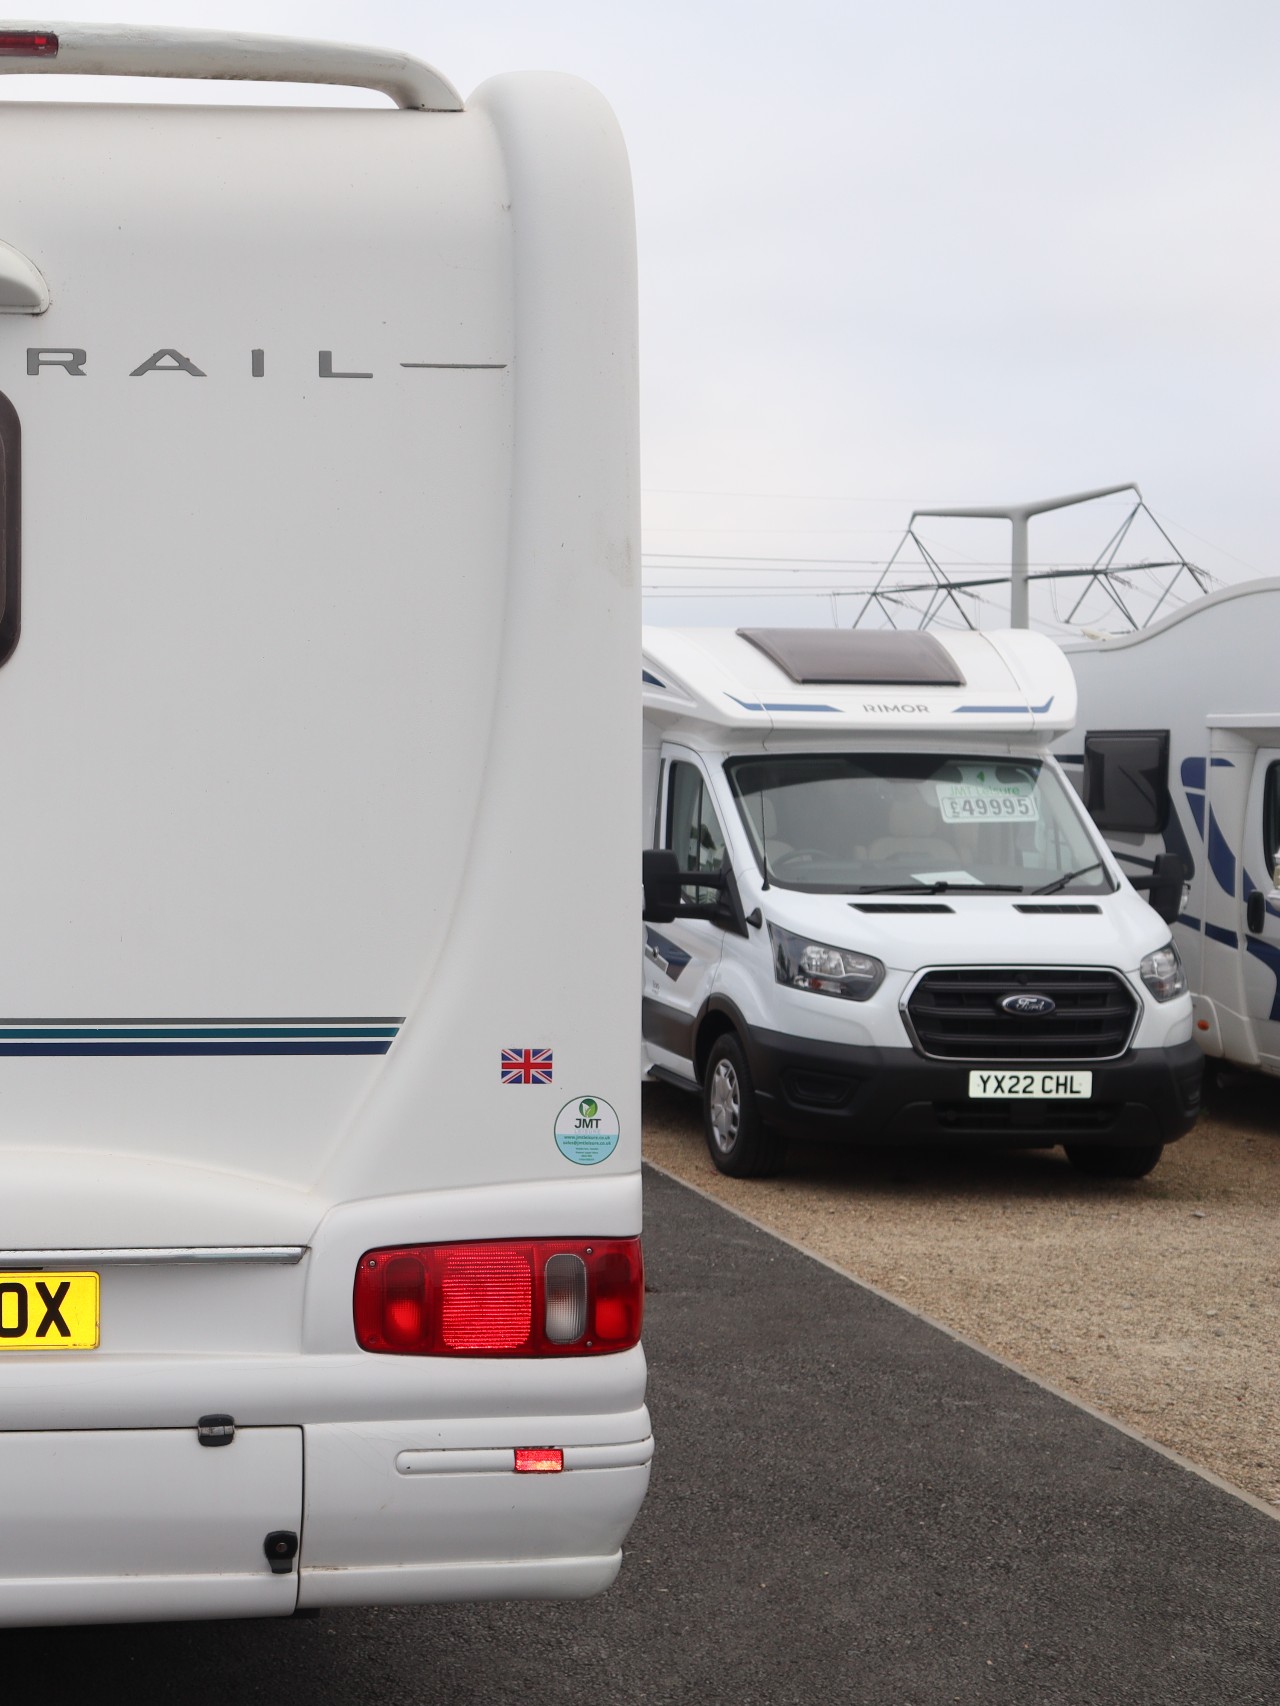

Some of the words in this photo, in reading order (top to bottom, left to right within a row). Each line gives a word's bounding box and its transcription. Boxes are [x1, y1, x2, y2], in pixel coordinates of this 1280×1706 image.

[862, 704, 930, 713] RIMOR
[950, 799, 1029, 817] £49995
[1016, 998, 1045, 1010] Ford
[979, 1075, 1034, 1094] YX22
[1042, 1075, 1081, 1094] CHL
[574, 1118, 602, 1129] JMT
